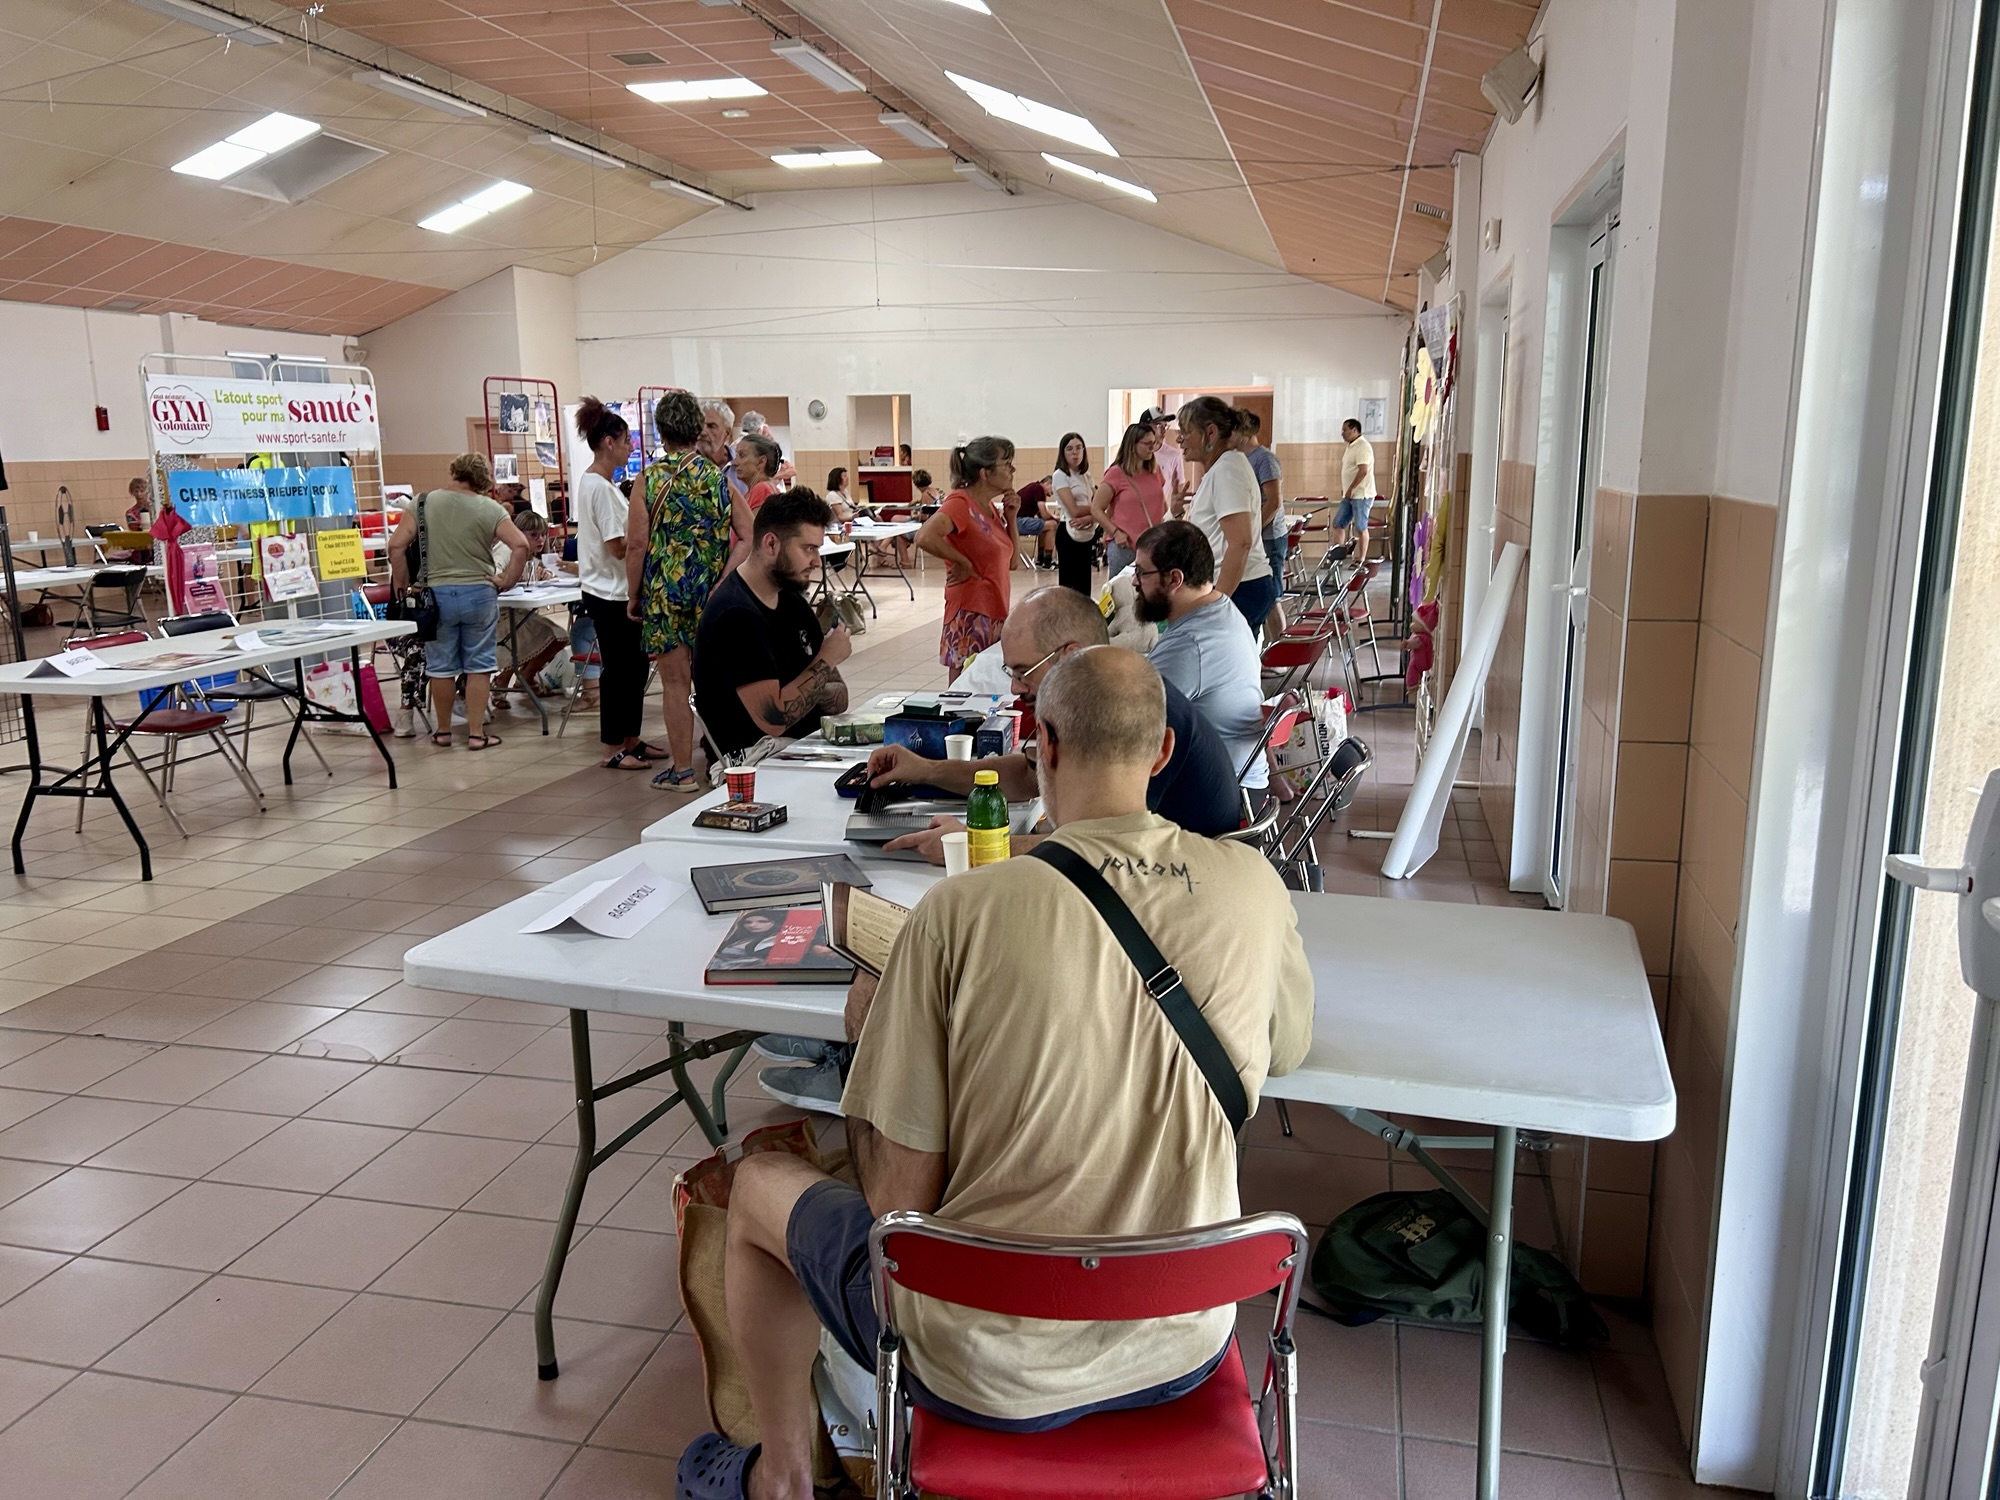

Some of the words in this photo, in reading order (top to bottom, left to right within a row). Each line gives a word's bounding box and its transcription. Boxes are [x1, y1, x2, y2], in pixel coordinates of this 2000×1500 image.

[214, 389, 254, 405] L'atout
[256, 393, 283, 409] sport
[242, 411, 267, 425] pour
[270, 412, 285, 422] ma
[288, 390, 363, 423] santé
[152, 399, 207, 422] GYM
[158, 420, 210, 431] volontaire
[256, 430, 347, 446] www.sport-sante.fr
[179, 487, 218, 503] CLUB
[223, 488, 266, 500] FITNESS
[1318, 723, 1330, 756] ACTION
